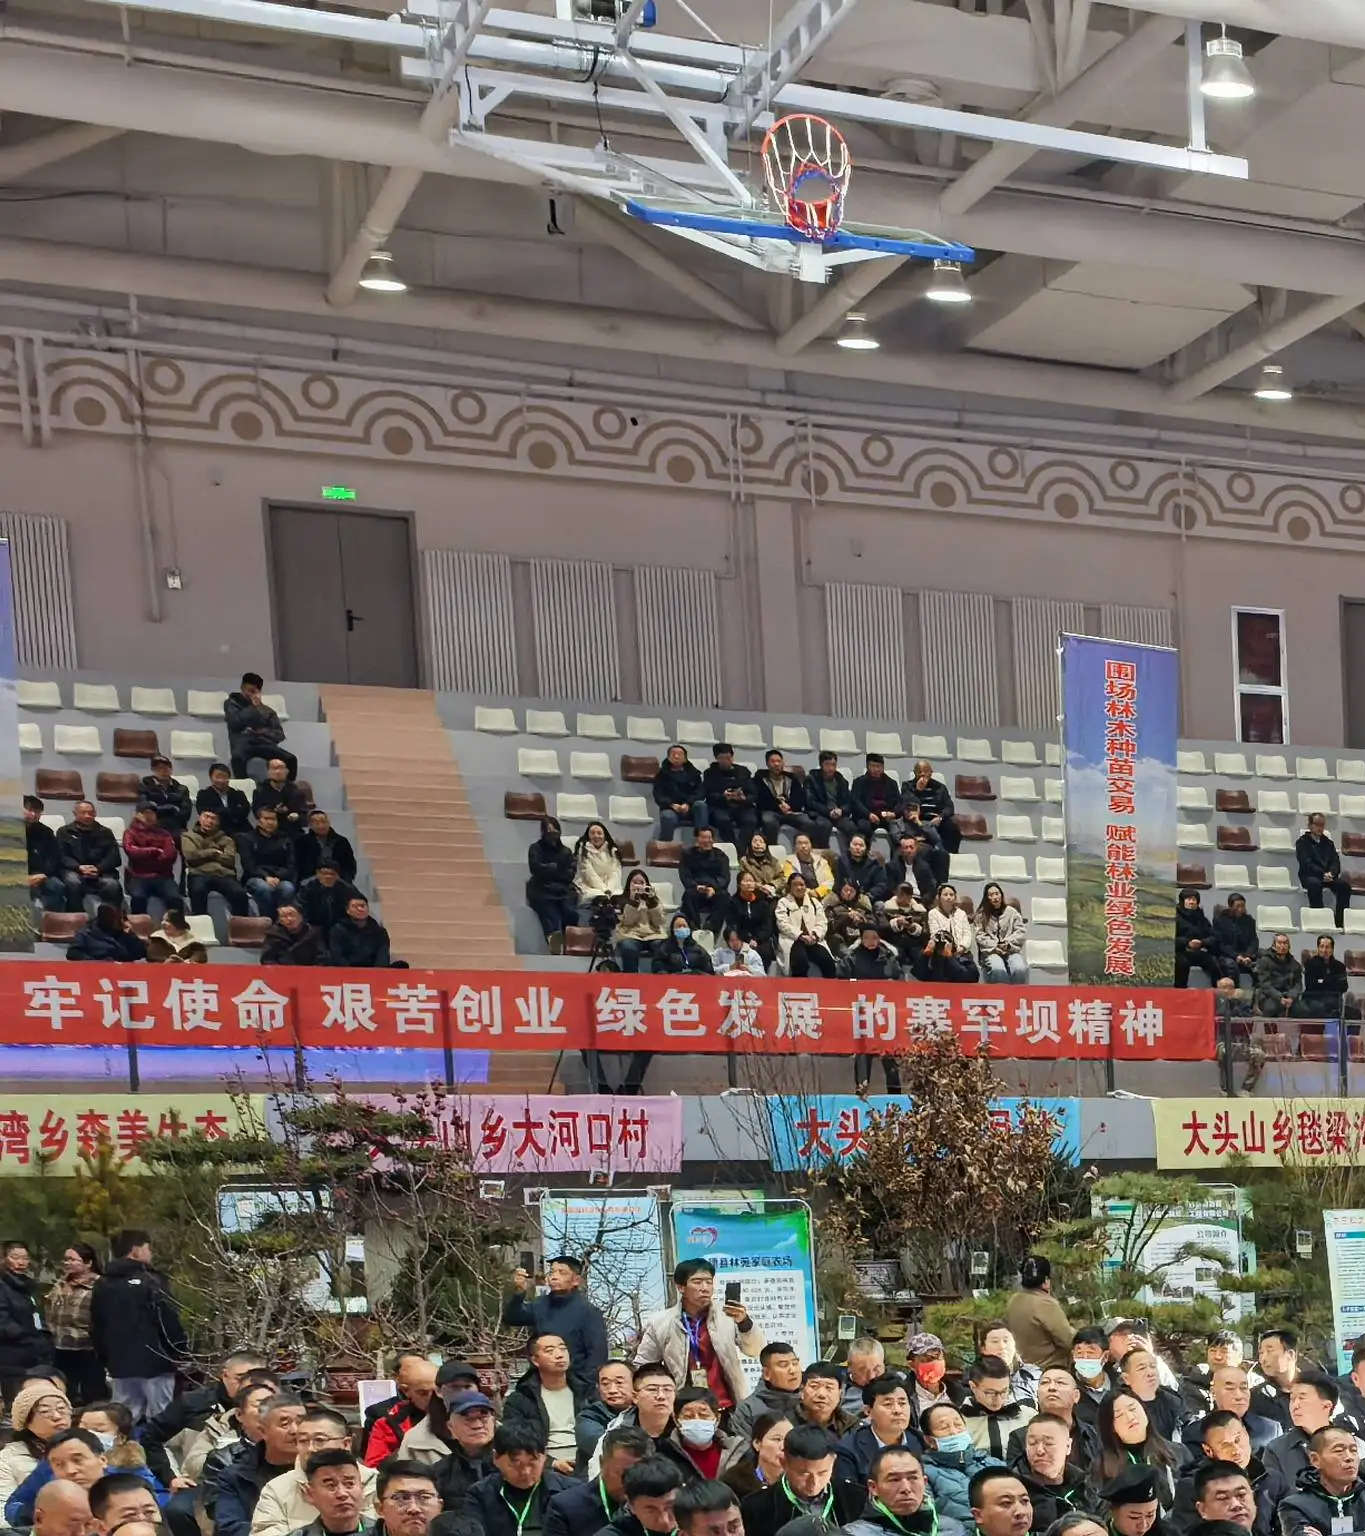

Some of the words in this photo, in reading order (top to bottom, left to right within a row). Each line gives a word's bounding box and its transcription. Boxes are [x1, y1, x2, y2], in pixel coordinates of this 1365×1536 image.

[1104, 660, 1137, 815] 围场林木种苗交易
[1104, 824, 1137, 976] 赋能林业绿色发展
[23, 975, 289, 1032] 牢记使命
[321, 981, 568, 1036] 艰苦创业
[595, 986, 823, 1038] 绿色发展
[851, 991, 1165, 1047] 的塞罕坝精神
